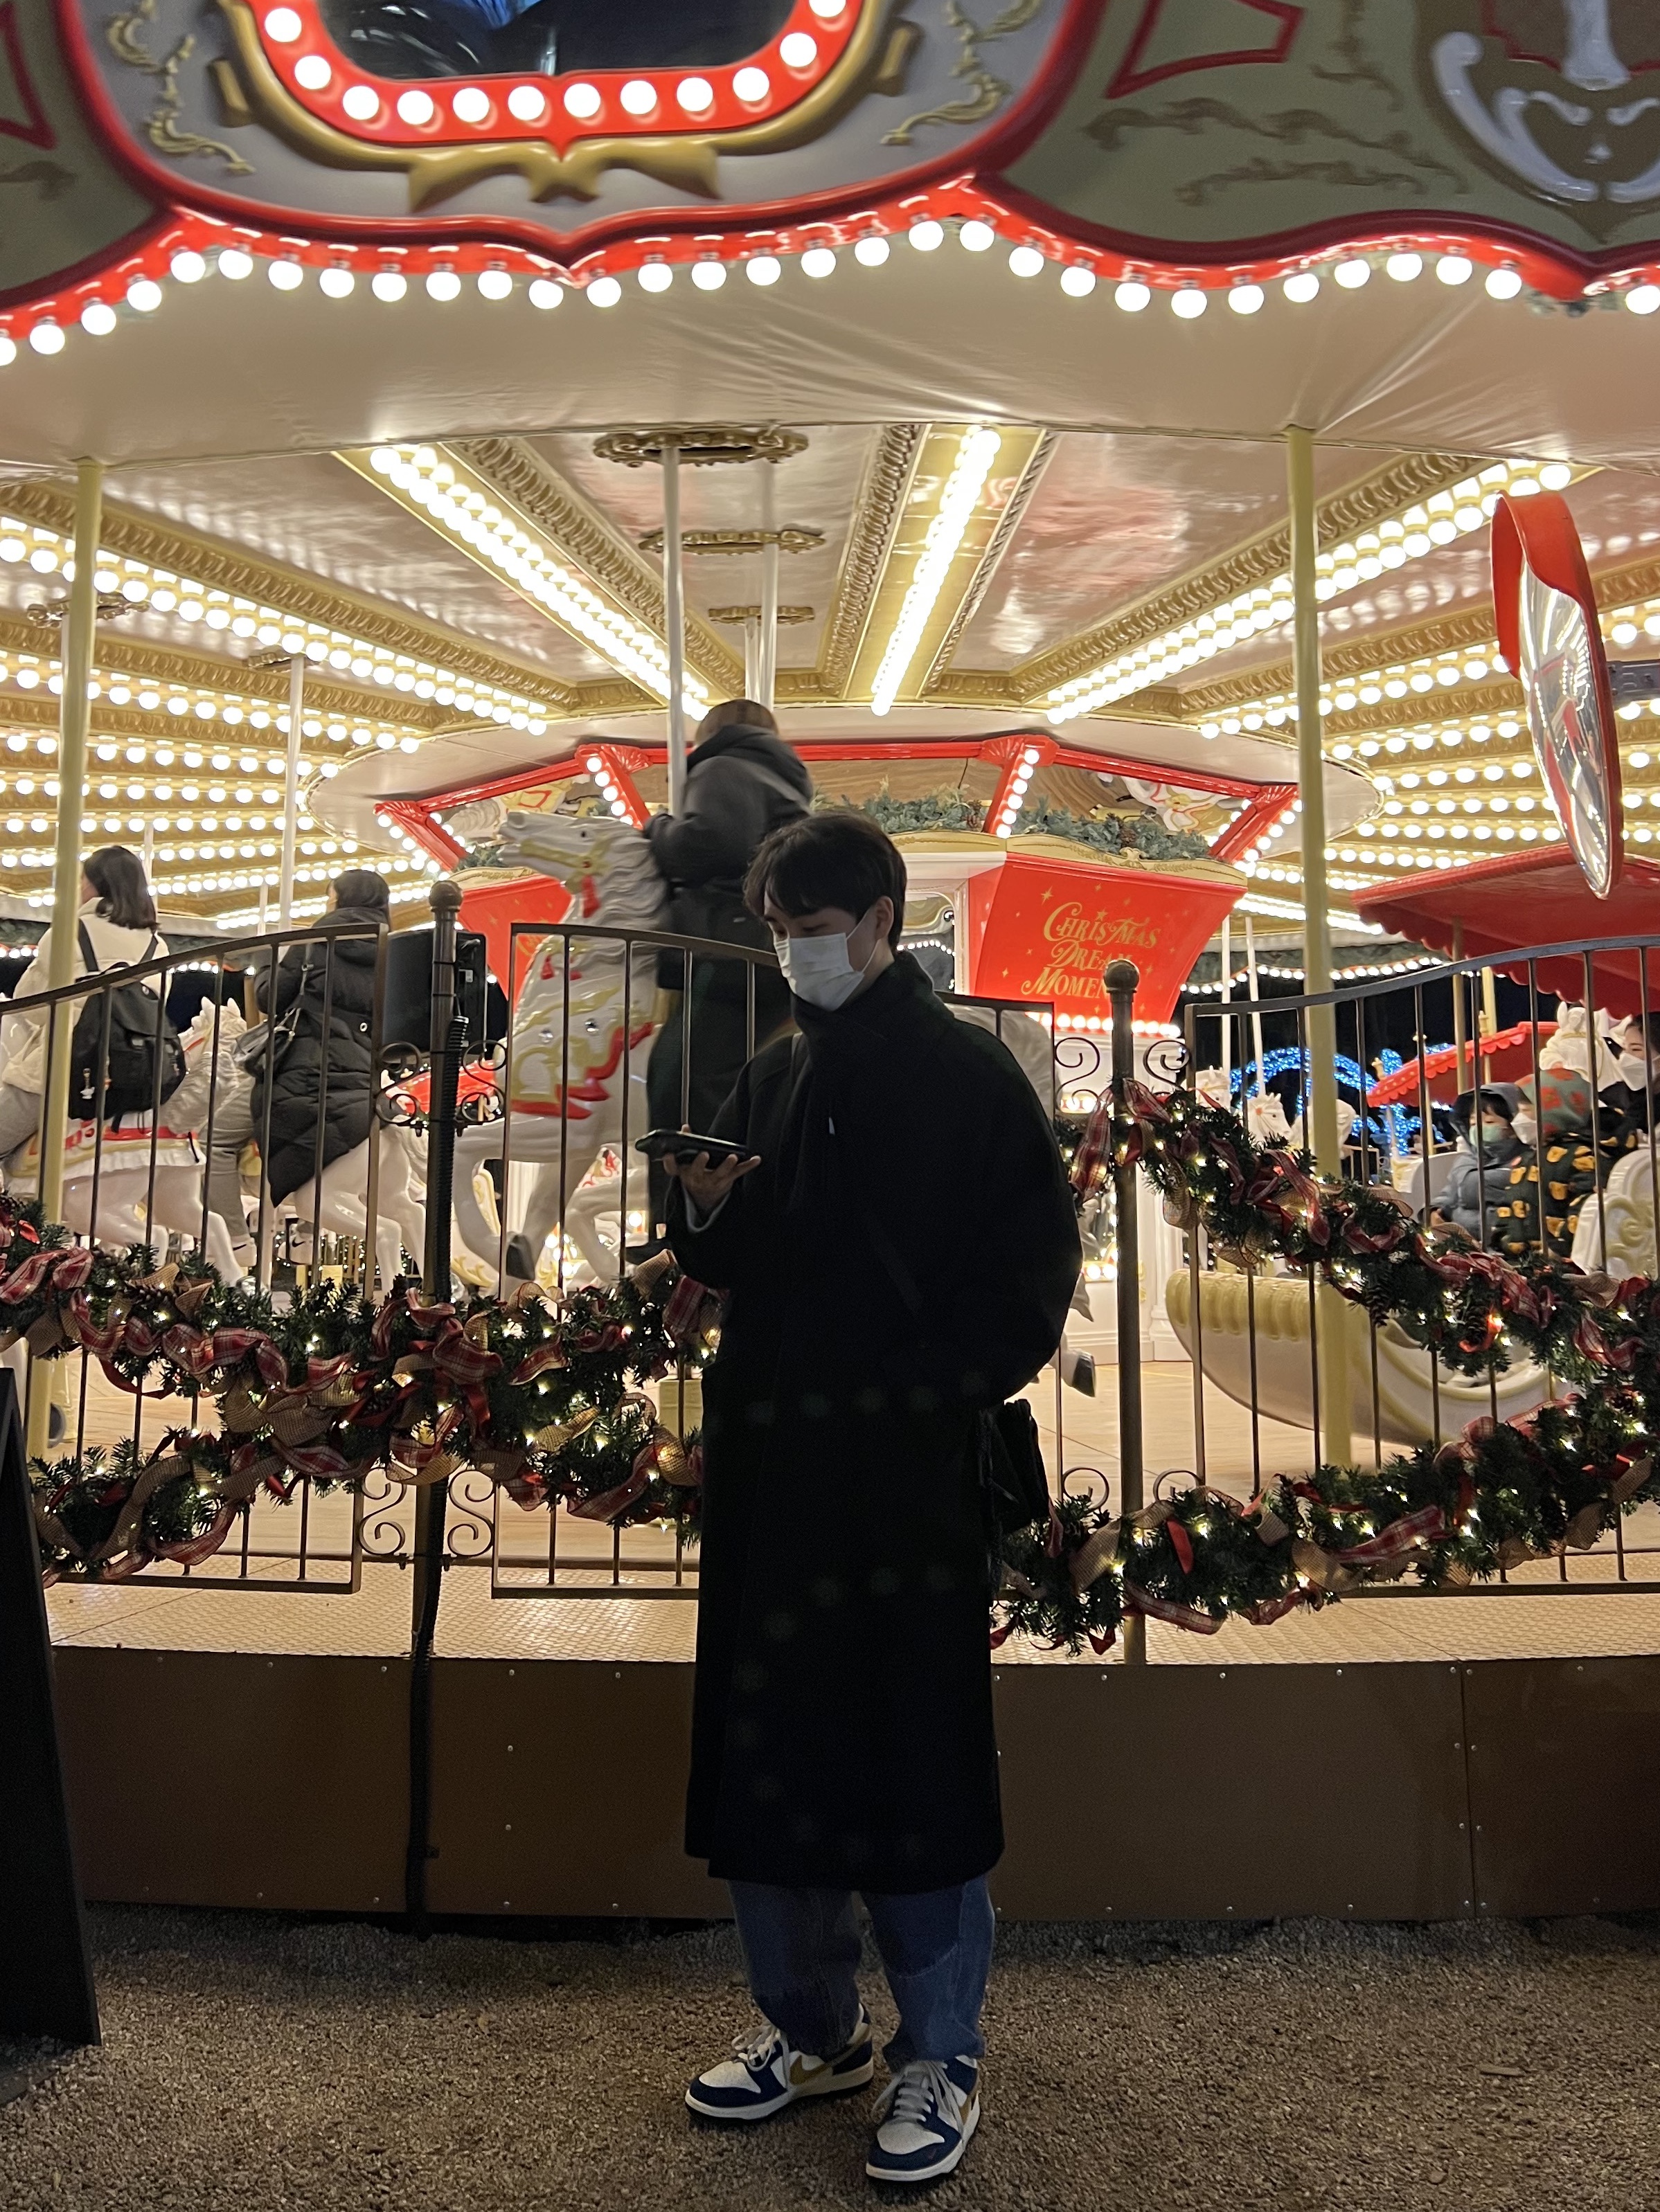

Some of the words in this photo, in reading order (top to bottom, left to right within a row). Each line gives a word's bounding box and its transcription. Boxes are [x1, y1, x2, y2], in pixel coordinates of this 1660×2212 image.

[1043, 901, 1161, 948] CHRISTMAS
[1046, 939, 1133, 971] DREA
[1020, 966, 1109, 999] MOMEN
